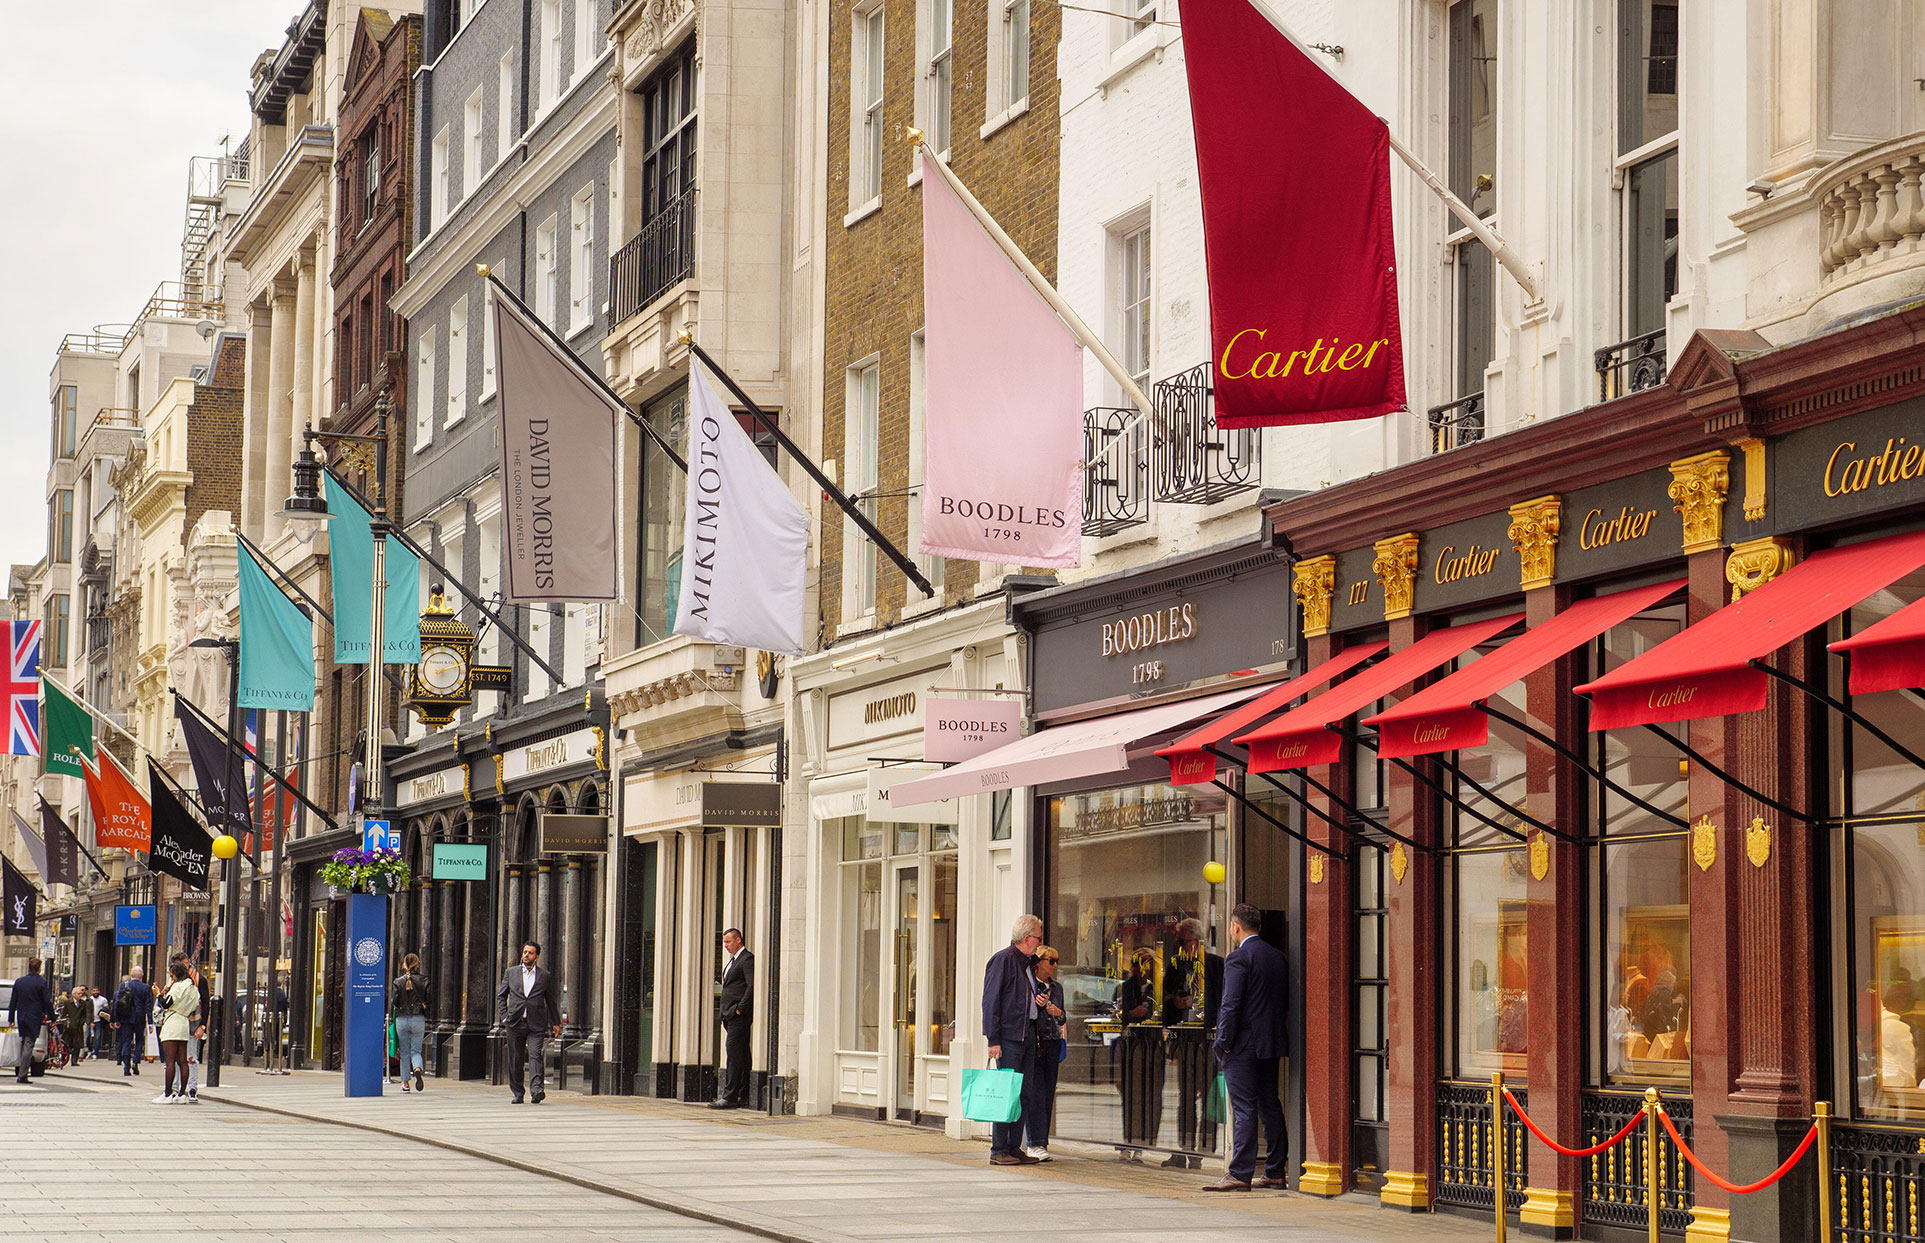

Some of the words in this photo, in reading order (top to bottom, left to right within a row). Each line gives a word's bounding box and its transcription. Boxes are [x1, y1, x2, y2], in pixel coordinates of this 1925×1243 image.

[1220, 328, 1389, 380] Cartier
[513, 449, 521, 467] THE
[529, 418, 551, 489] DAVID
[514, 470, 523, 510] LONDON
[690, 416, 721, 622] MIKIMOTO
[939, 496, 1066, 529] BOODLES
[515, 513, 525, 560] JEWELLER
[984, 527, 1021, 542] 1798
[1580, 506, 1659, 551] Cartier
[532, 495, 554, 589] MORRIS
[1435, 545, 1501, 585] Cartier
[1348, 580, 1370, 606] 177
[1102, 603, 1193, 657] BOODLES
[340, 641, 387, 651] TIFF
[1271, 639, 1285, 656] 178
[1132, 660, 1161, 684] 1798
[864, 691, 916, 725] MIKIMOTO
[1647, 686, 1699, 710] Cartier
[938, 720, 1008, 733] BOODLES
[963, 734, 984, 742] 1798
[1413, 720, 1451, 745] Cartier
[53, 752, 83, 767] ROLE
[1276, 738, 1309, 760] Cartier
[1178, 756, 1206, 776] Cartier
[980, 771, 1010, 788] BOODLES
[112, 814, 148, 831] ROYL
[704, 808, 735, 816] DAVID
[740, 809, 780, 817] MORRIS
[544, 836, 571, 845] DAVID
[574, 838, 608, 846] MORRIS
[438, 857, 465, 866] TIFFANY
[465, 858, 471, 866] &
[183, 891, 211, 900] BROWNS
